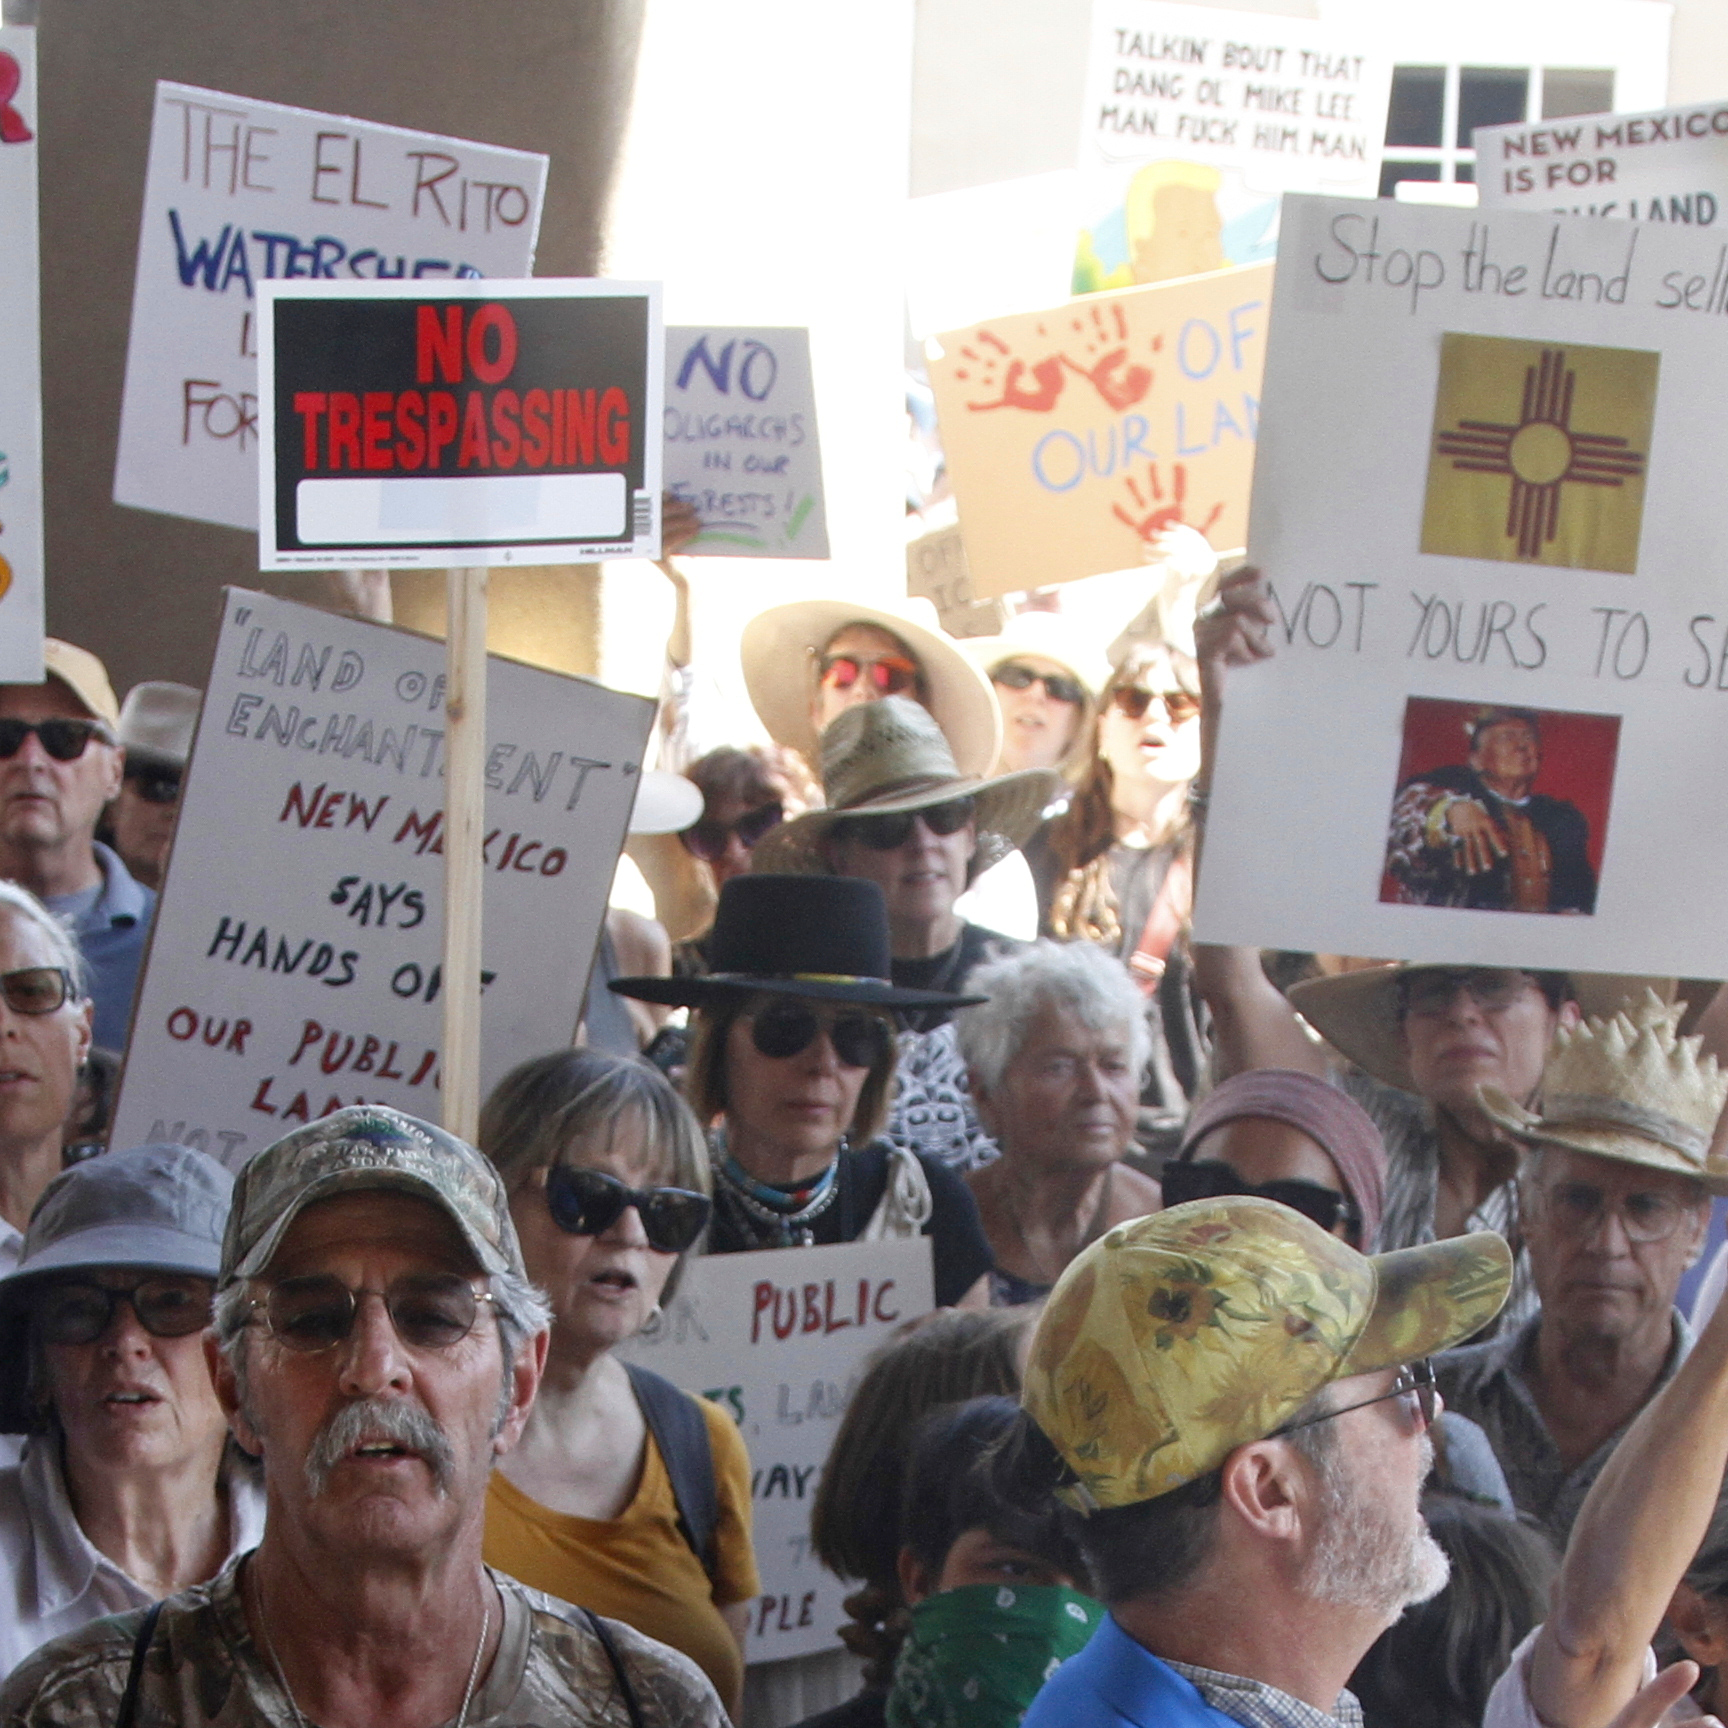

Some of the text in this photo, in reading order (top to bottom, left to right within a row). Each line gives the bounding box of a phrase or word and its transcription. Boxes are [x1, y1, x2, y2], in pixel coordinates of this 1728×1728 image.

[1113, 68, 1186, 101] DANG
[1243, 83, 1304, 115] MIKE
[1300, 49, 1367, 83] THAT
[1175, 113, 1239, 145] FUCK
[1502, 127, 1584, 160] NEW
[164, 98, 529, 232] THE EL RITO
[1503, 158, 1617, 194] IS FOR
[1314, 214, 1446, 314] Stop
[1461, 226, 1530, 297] the
[1539, 226, 1631, 305] land
[415, 302, 519, 385] NO
[675, 333, 778, 402] NO
[293, 387, 631, 472] TRESPASSING
[663, 405, 807, 446] OLIGARCHS
[1032, 403, 1156, 495] OUR
[703, 450, 791, 476] IN OUR
[1406, 592, 1550, 671] YOURS
[1592, 606, 1650, 682] TO
[278, 780, 391, 832] NEW
[329, 875, 426, 930] SAYS
[206, 916, 360, 987] HANDS
[166, 1005, 443, 1093] OUR PUBLI
[749, 1277, 900, 1344] PUBLIC
